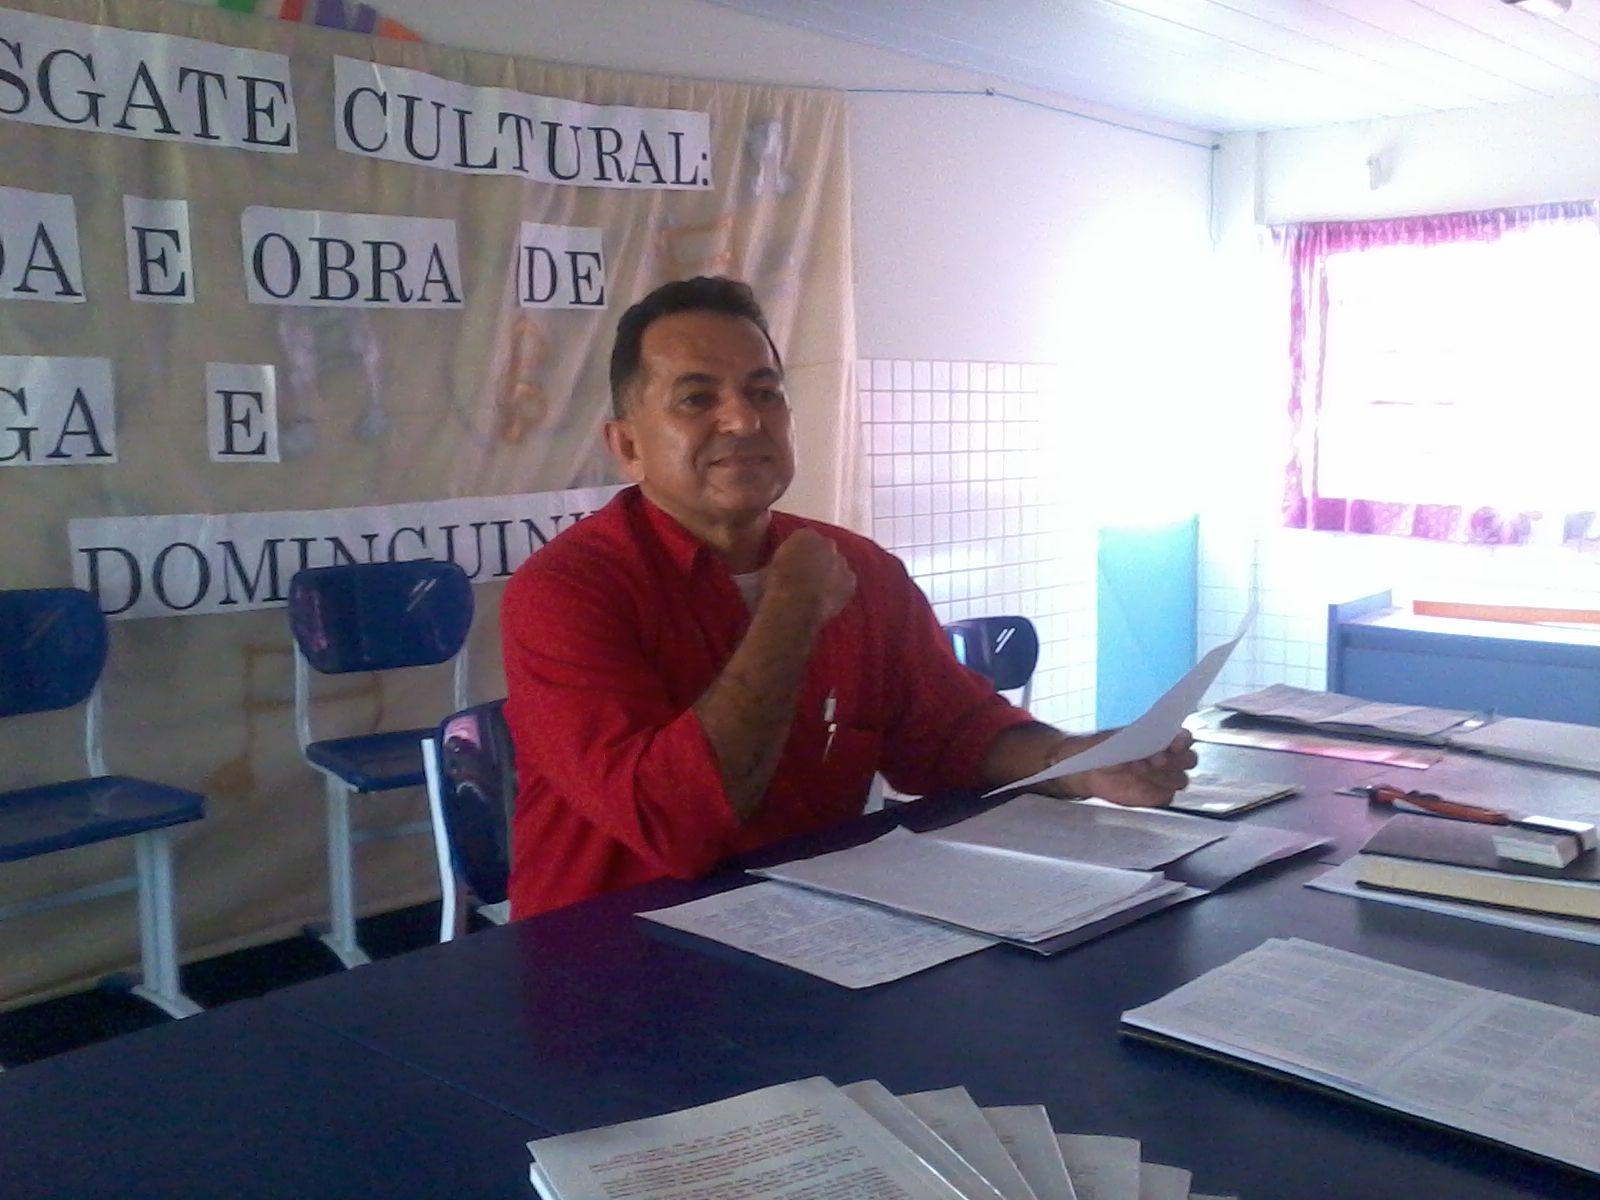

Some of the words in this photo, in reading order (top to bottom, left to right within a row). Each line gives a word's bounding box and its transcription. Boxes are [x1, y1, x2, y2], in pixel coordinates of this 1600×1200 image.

[343, 87, 709, 187] CULTURAL:
[132, 226, 186, 296] E
[253, 233, 461, 303] OBRA
[521, 245, 605, 305] DE
[215, 390, 267, 455] E
